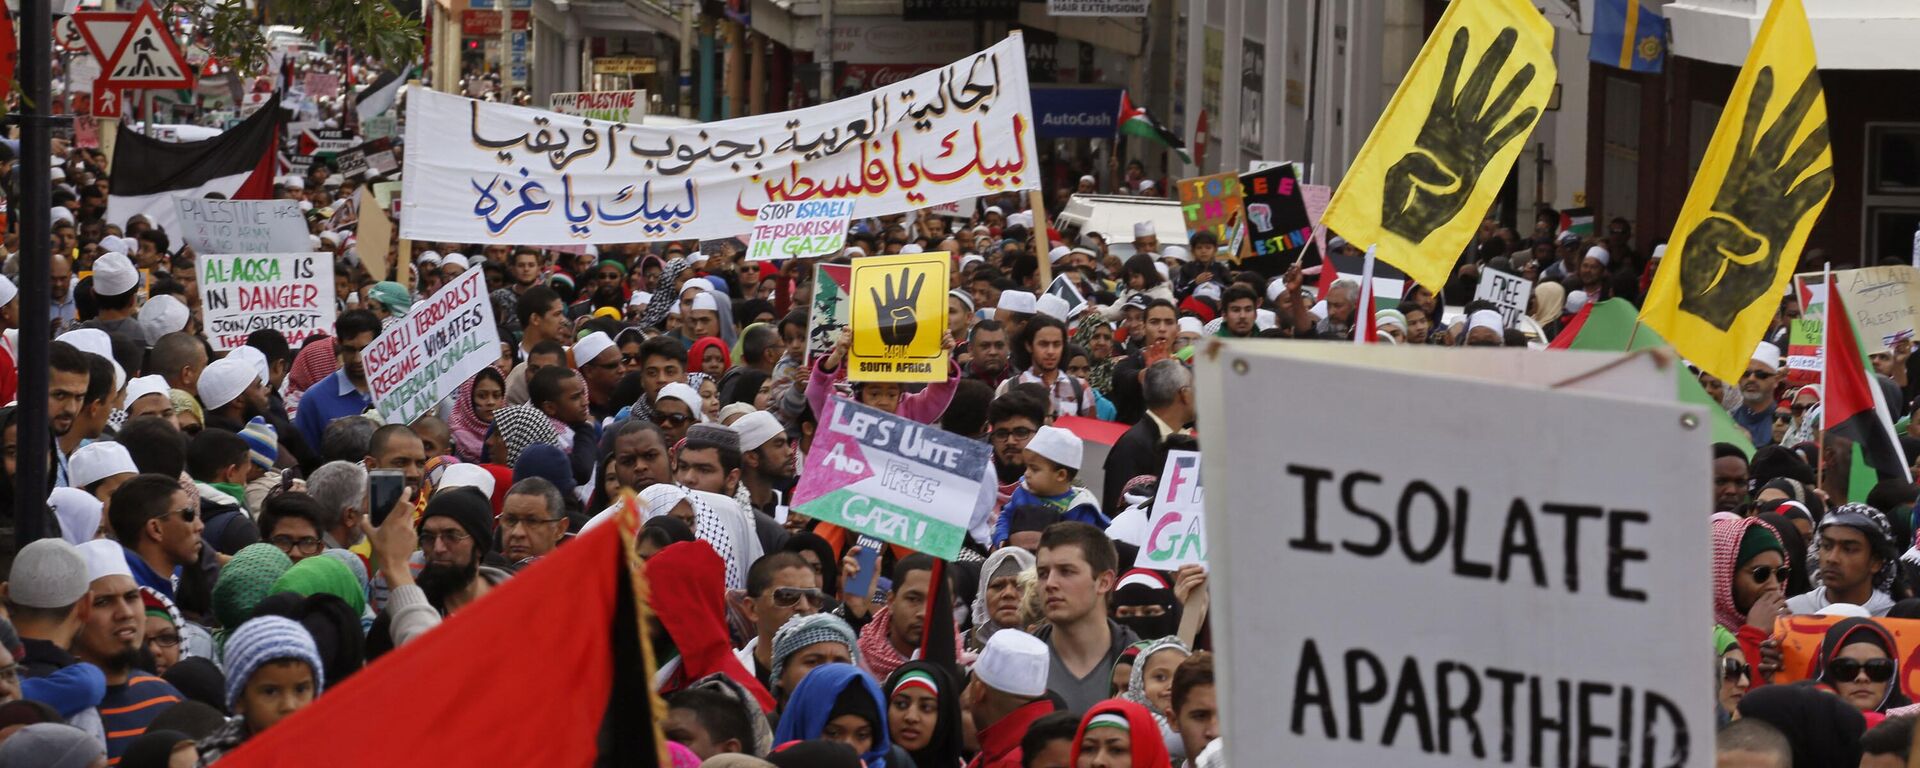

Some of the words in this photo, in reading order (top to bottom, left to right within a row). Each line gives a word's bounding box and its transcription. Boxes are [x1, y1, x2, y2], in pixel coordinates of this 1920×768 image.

[1053, 3, 1079, 12] HAIR
[1081, 4, 1145, 13] EXTENSIONS
[1042, 112, 1111, 126] AutoCash
[320, 130, 342, 138] FREE
[630, 129, 766, 176] بجنوب
[1183, 178, 1236, 201] STOP
[180, 200, 267, 225] PALESTINE
[759, 202, 795, 221] STOP
[214, 225, 232, 237] NO
[754, 220, 844, 240] TERRORISM
[752, 240, 775, 258] IN
[781, 234, 842, 255] GAZA
[205, 256, 281, 286] AL-AQSA
[294, 257, 315, 280] IS
[1849, 269, 1913, 292] ALLAH
[206, 287, 230, 312] IN
[238, 284, 319, 312] DANGER
[1490, 275, 1522, 305] FREE
[1863, 286, 1905, 304] SAVE
[211, 313, 323, 334] JOIN/SUPPORT
[364, 322, 411, 377] ISRAELI
[412, 271, 480, 337] TERRORIST
[1856, 305, 1917, 328] PALESTINE
[370, 345, 422, 400] REGIME
[423, 303, 483, 358] VIOLATES
[379, 330, 491, 420] INTERNATIONAL
[860, 361, 893, 373] SOUTH
[896, 362, 932, 373] AFRICA
[401, 382, 439, 425] LAW
[881, 458, 941, 504] FREE
[1285, 463, 1651, 604] ISOLATE
[1289, 637, 1691, 768] APARTHEID
